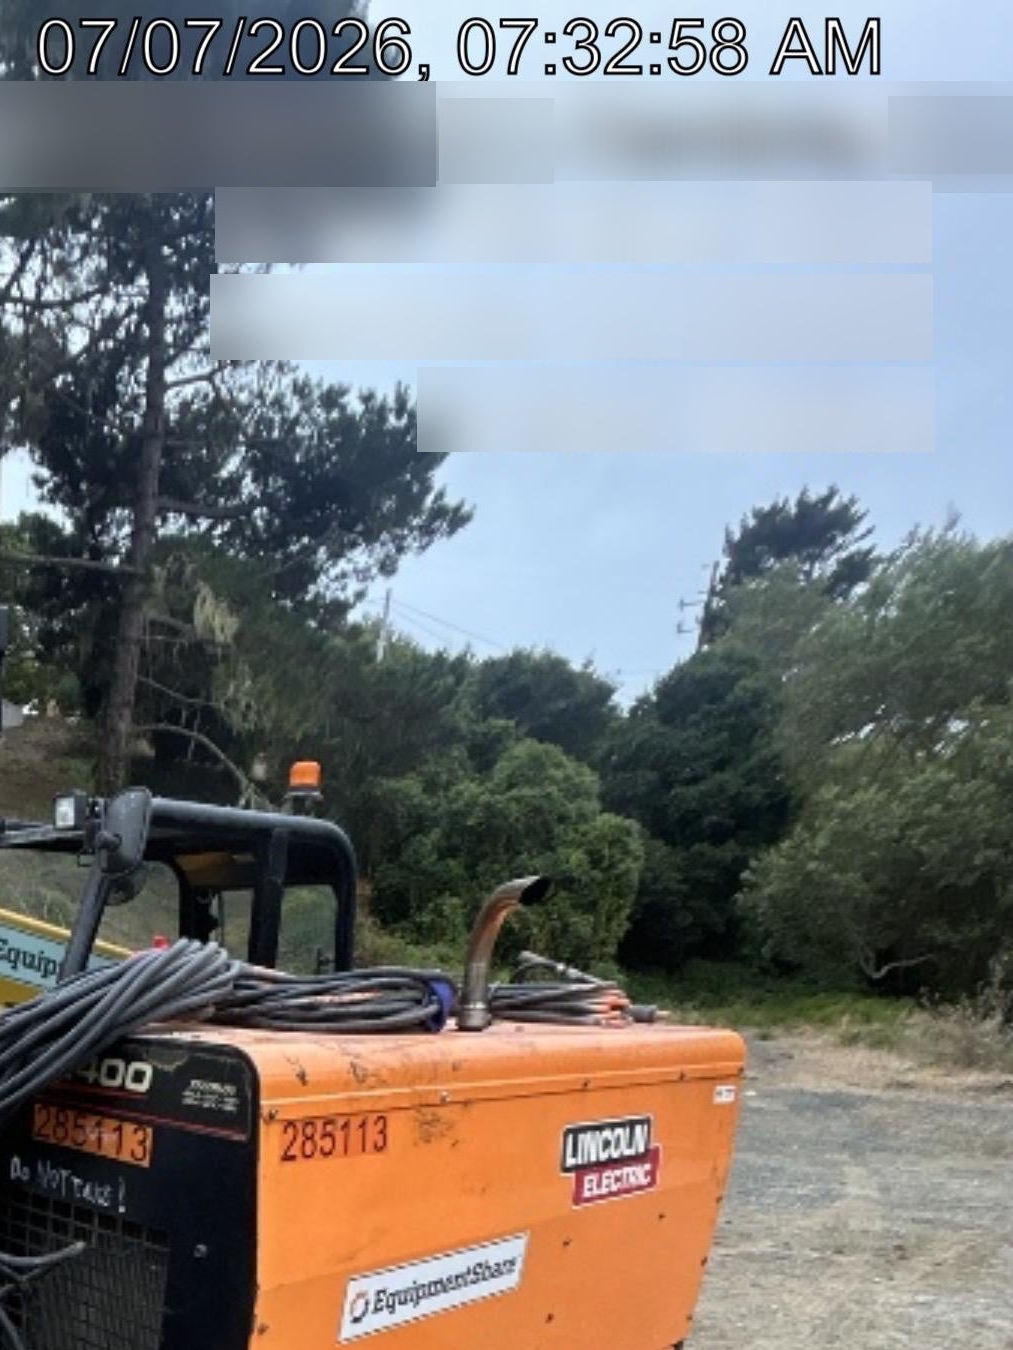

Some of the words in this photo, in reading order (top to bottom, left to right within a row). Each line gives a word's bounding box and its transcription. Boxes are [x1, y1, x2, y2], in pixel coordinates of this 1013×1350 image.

[34, 1104, 148, 1162] 285113
[281, 1115, 388, 1161] 285113
[565, 1124, 649, 1168] LINCOLN
[583, 1163, 653, 1198] ELECTRIC
